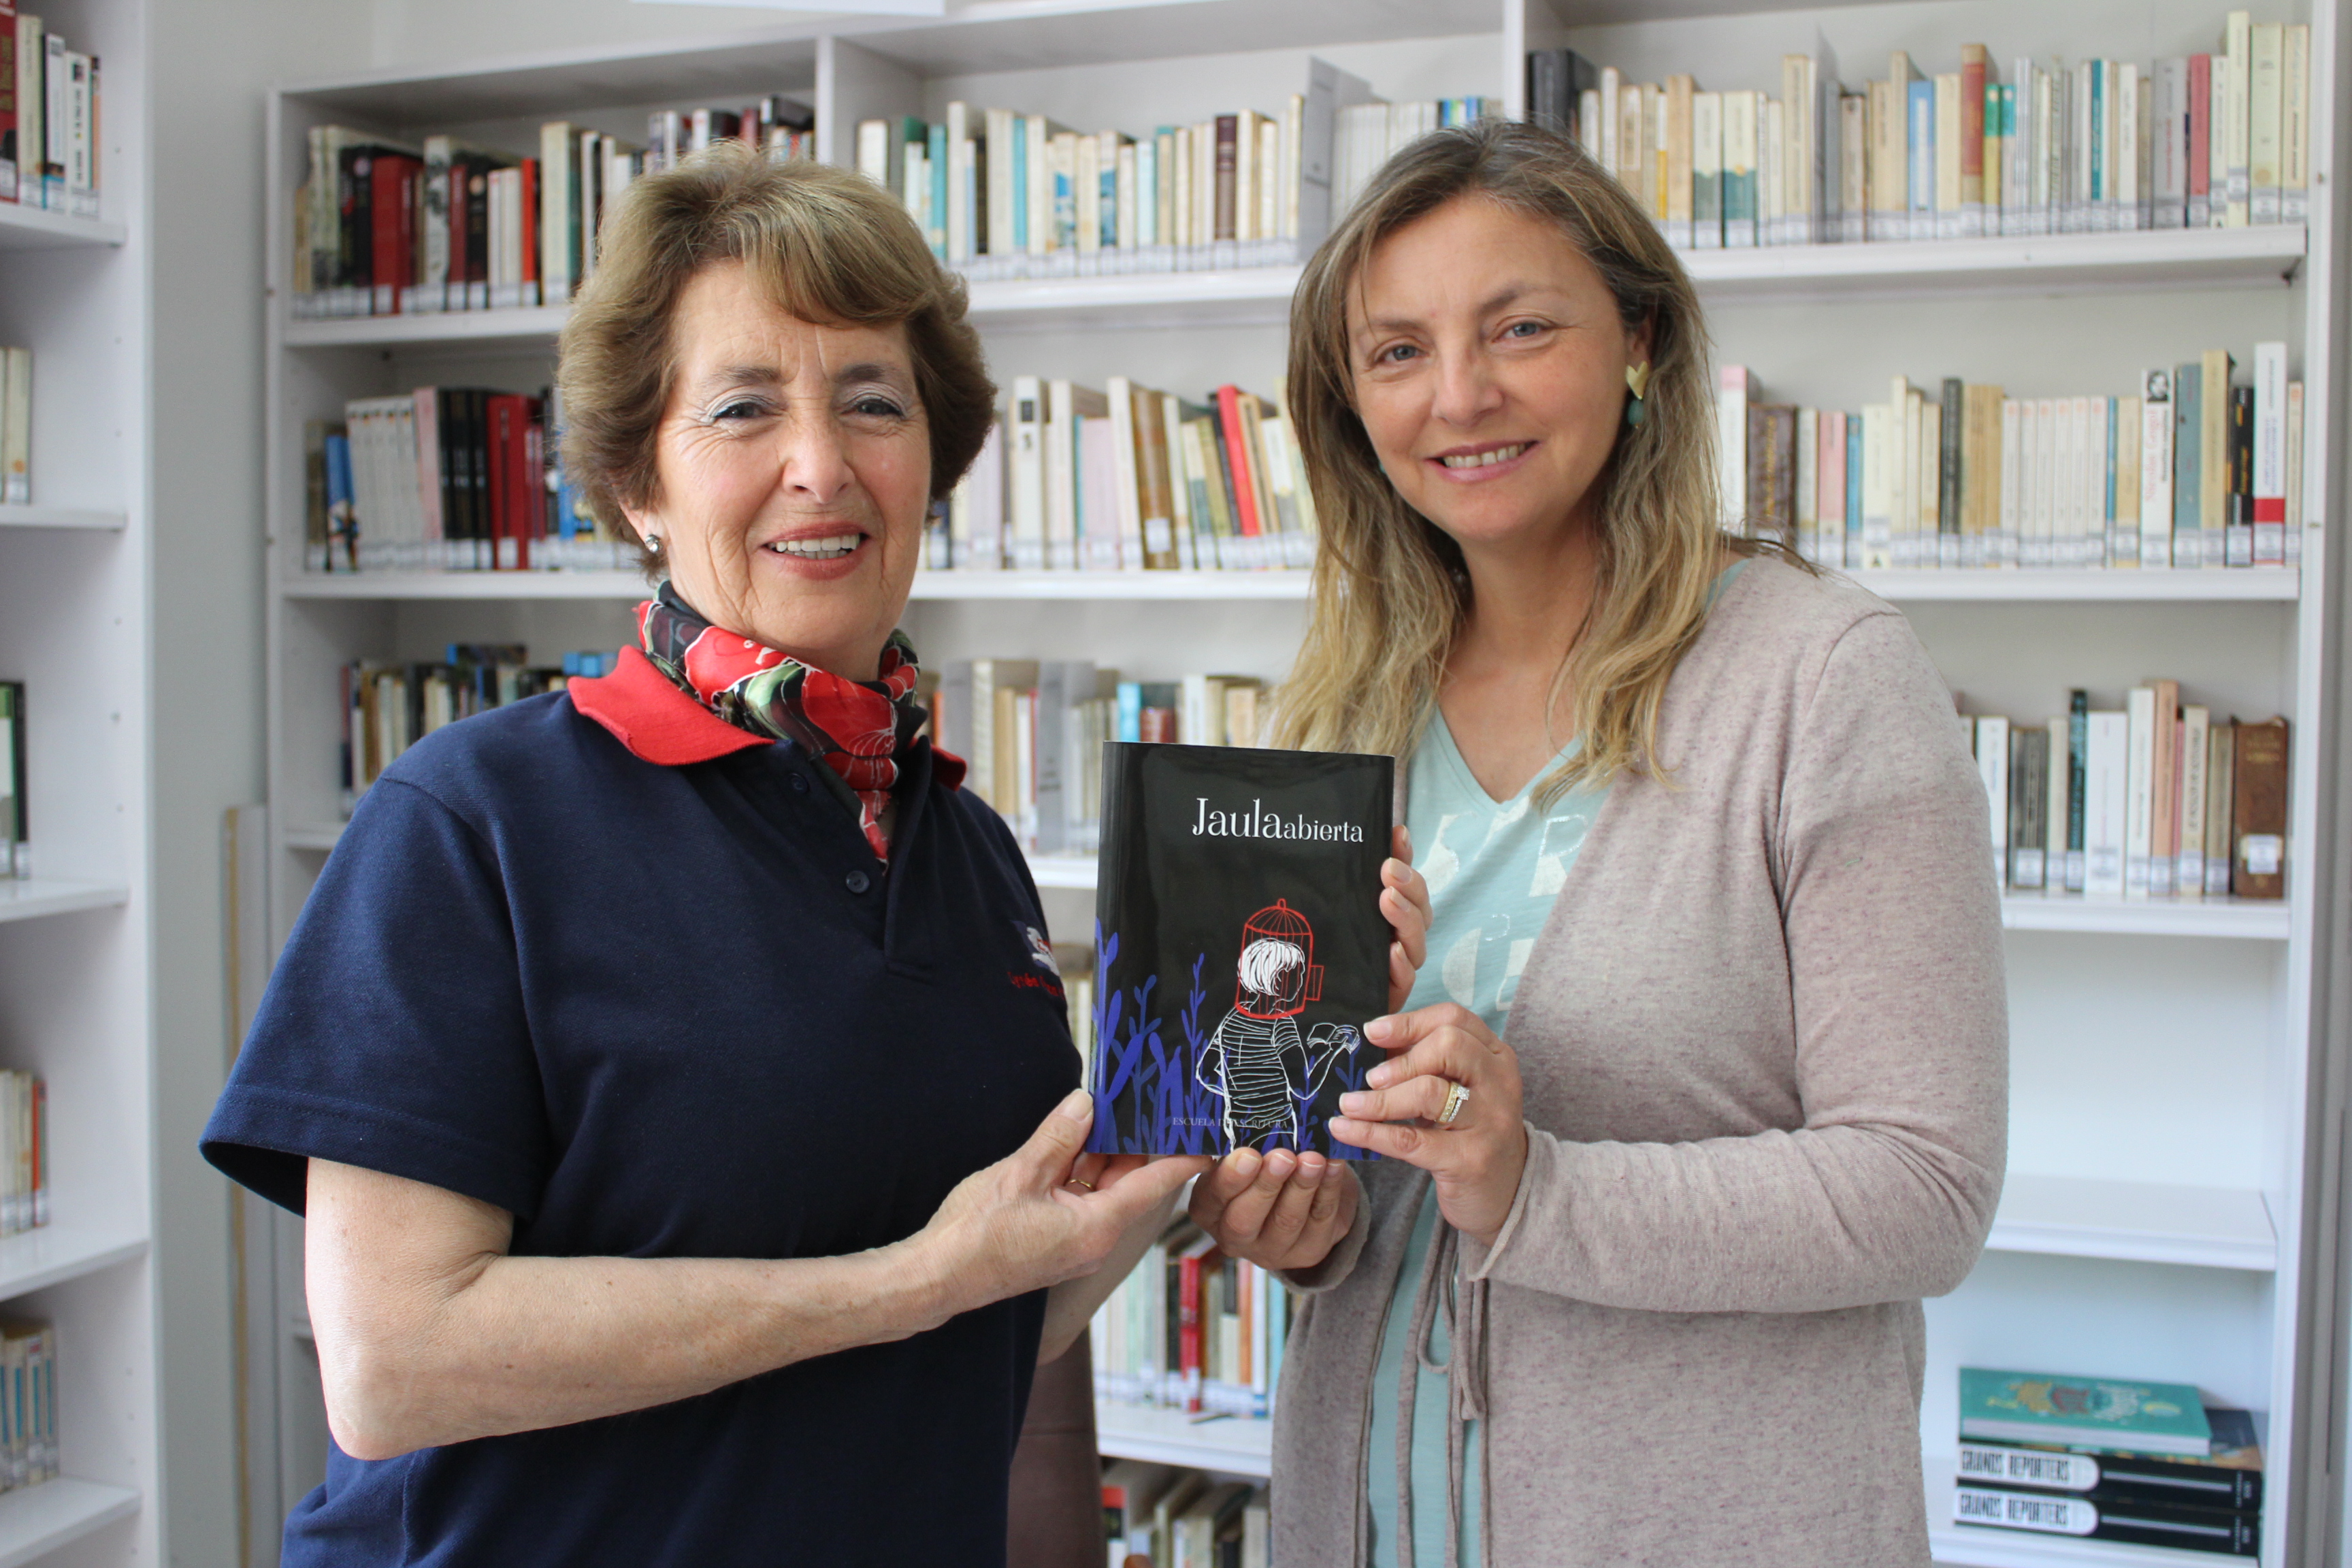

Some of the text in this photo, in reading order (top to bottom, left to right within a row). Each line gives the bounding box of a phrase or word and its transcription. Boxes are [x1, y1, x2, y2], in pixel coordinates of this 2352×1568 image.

[1173, 1117, 1215, 1127] ESCUELA
[1962, 1450, 2068, 1482] GRANDS REPORTERS
[1961, 1494, 2067, 1526] GRANDS REPORTERS
